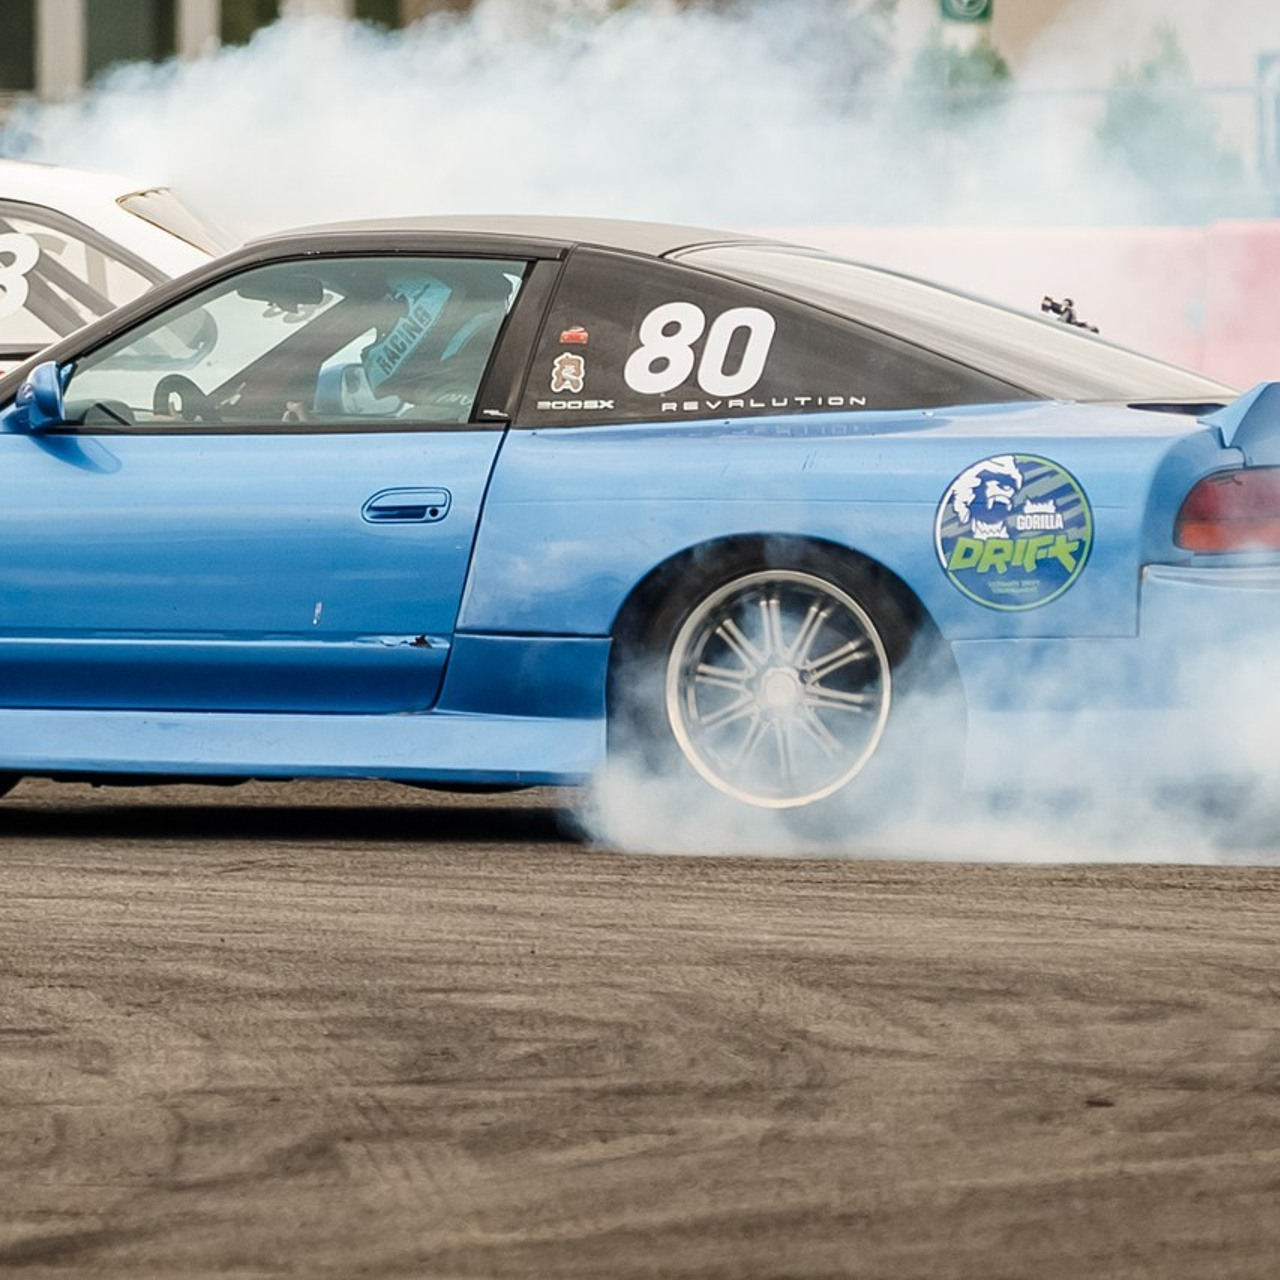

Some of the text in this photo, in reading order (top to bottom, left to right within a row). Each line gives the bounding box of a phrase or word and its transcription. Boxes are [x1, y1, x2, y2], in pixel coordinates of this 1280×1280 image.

[376, 306, 433, 376] RACING
[624, 301, 776, 397] 80
[1016, 514, 1064, 530] GORILLA
[947, 535, 1080, 574] DRIFT
